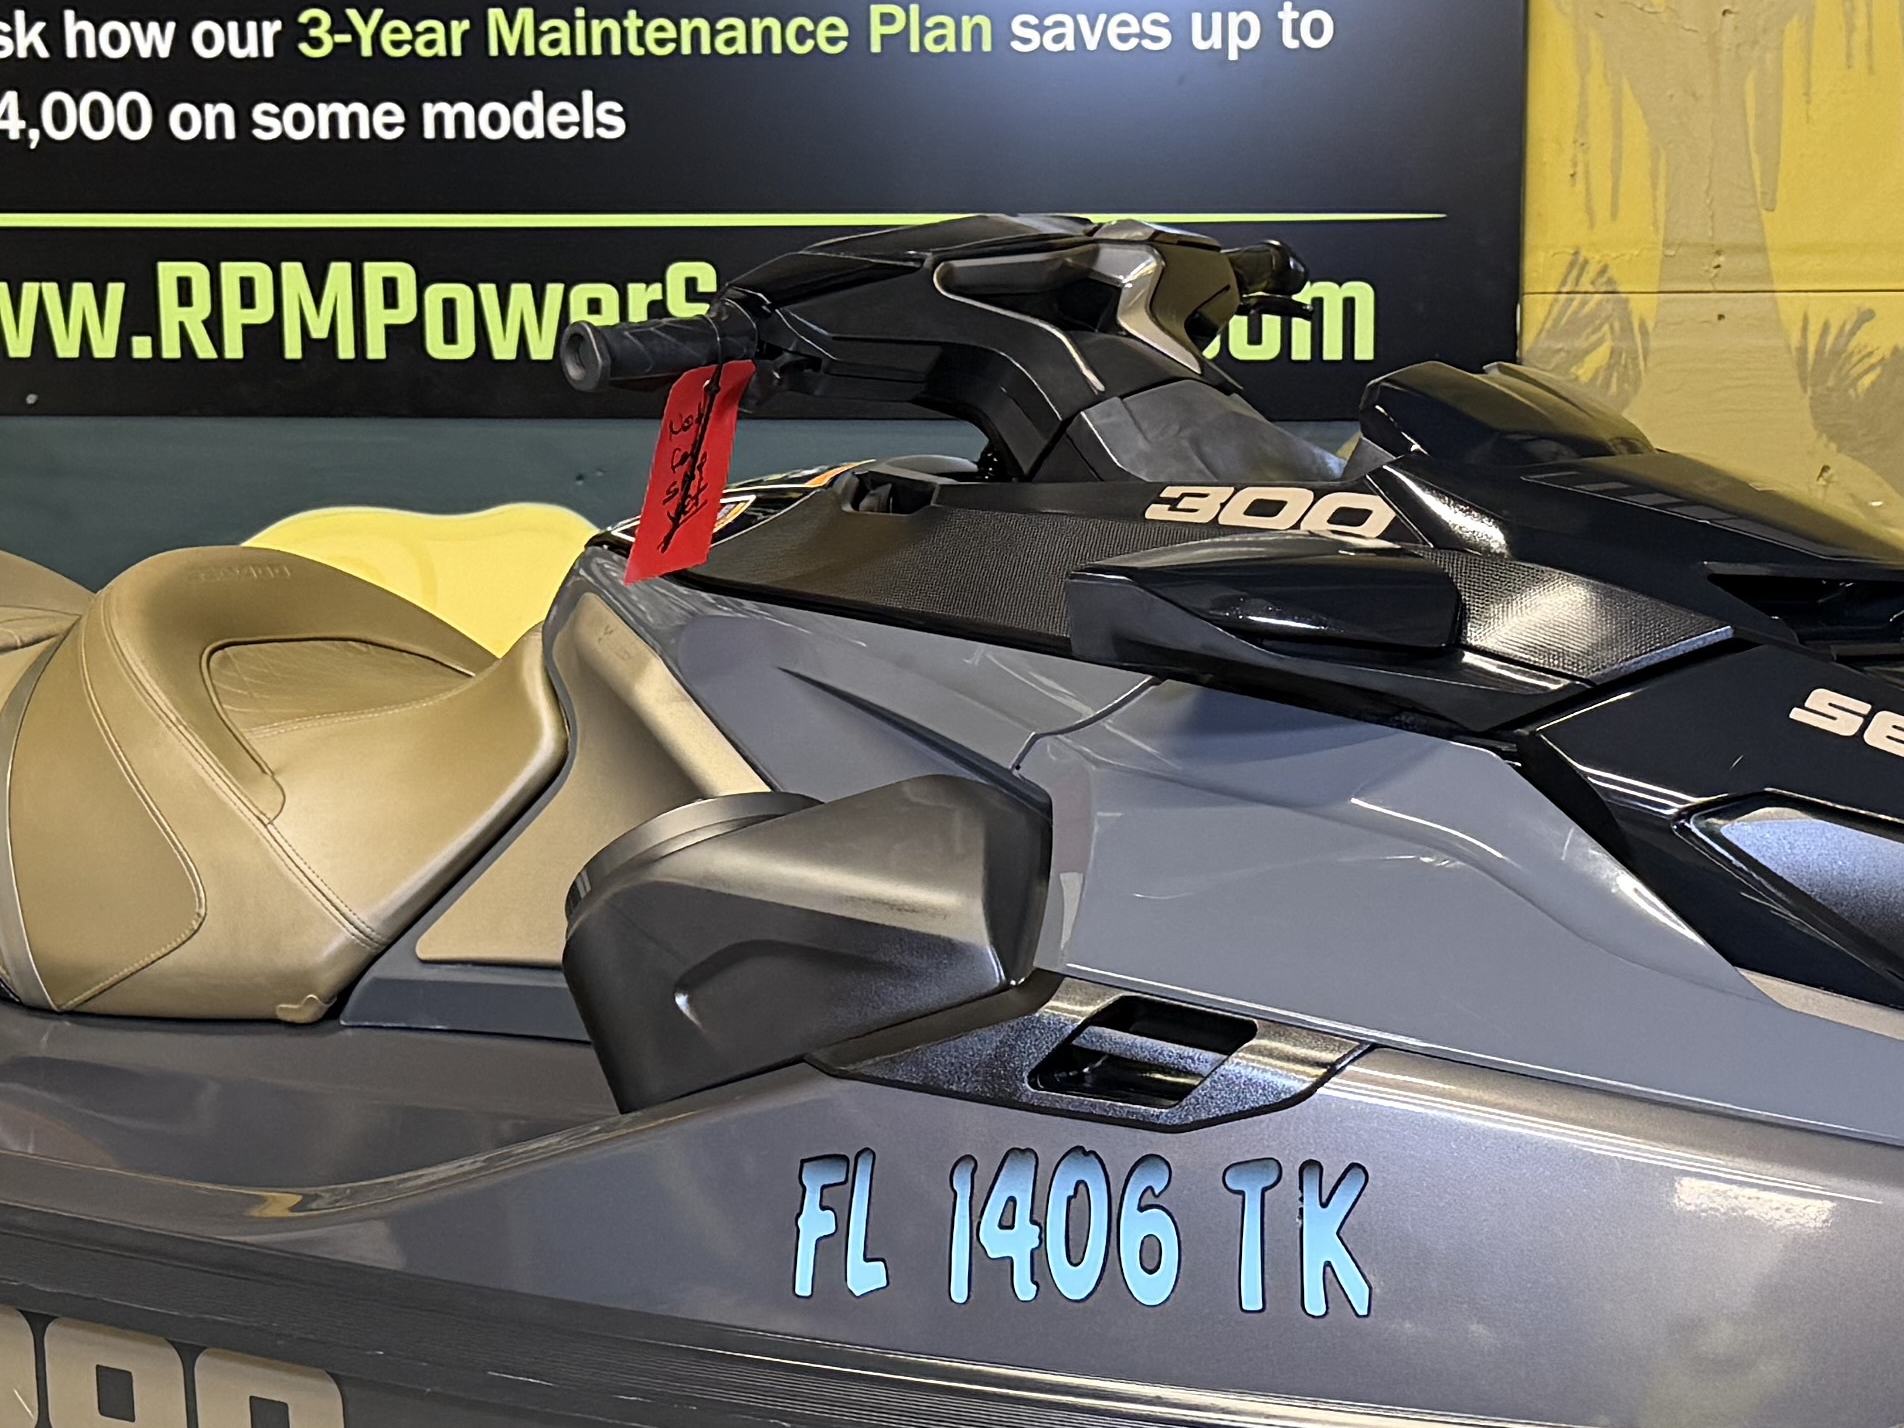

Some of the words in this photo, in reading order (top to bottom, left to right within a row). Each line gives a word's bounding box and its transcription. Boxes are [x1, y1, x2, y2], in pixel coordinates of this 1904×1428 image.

[64, 10, 176, 58] how
[192, 20, 282, 58] our
[298, 8, 470, 57] 3-Year
[488, 7, 848, 56] Maintenance
[870, 4, 991, 52] Plan
[1010, 13, 1171, 52] saves
[1192, 11, 1260, 60] up
[1278, 2, 1333, 48] to
[169, 103, 235, 140] on
[252, 102, 405, 140] some
[423, 90, 626, 139] models
[1145, 486, 1397, 539] 300
[793, 1147, 887, 1298] FL
[949, 1145, 1181, 1309] 1406
[1222, 1156, 1374, 1320] TK
